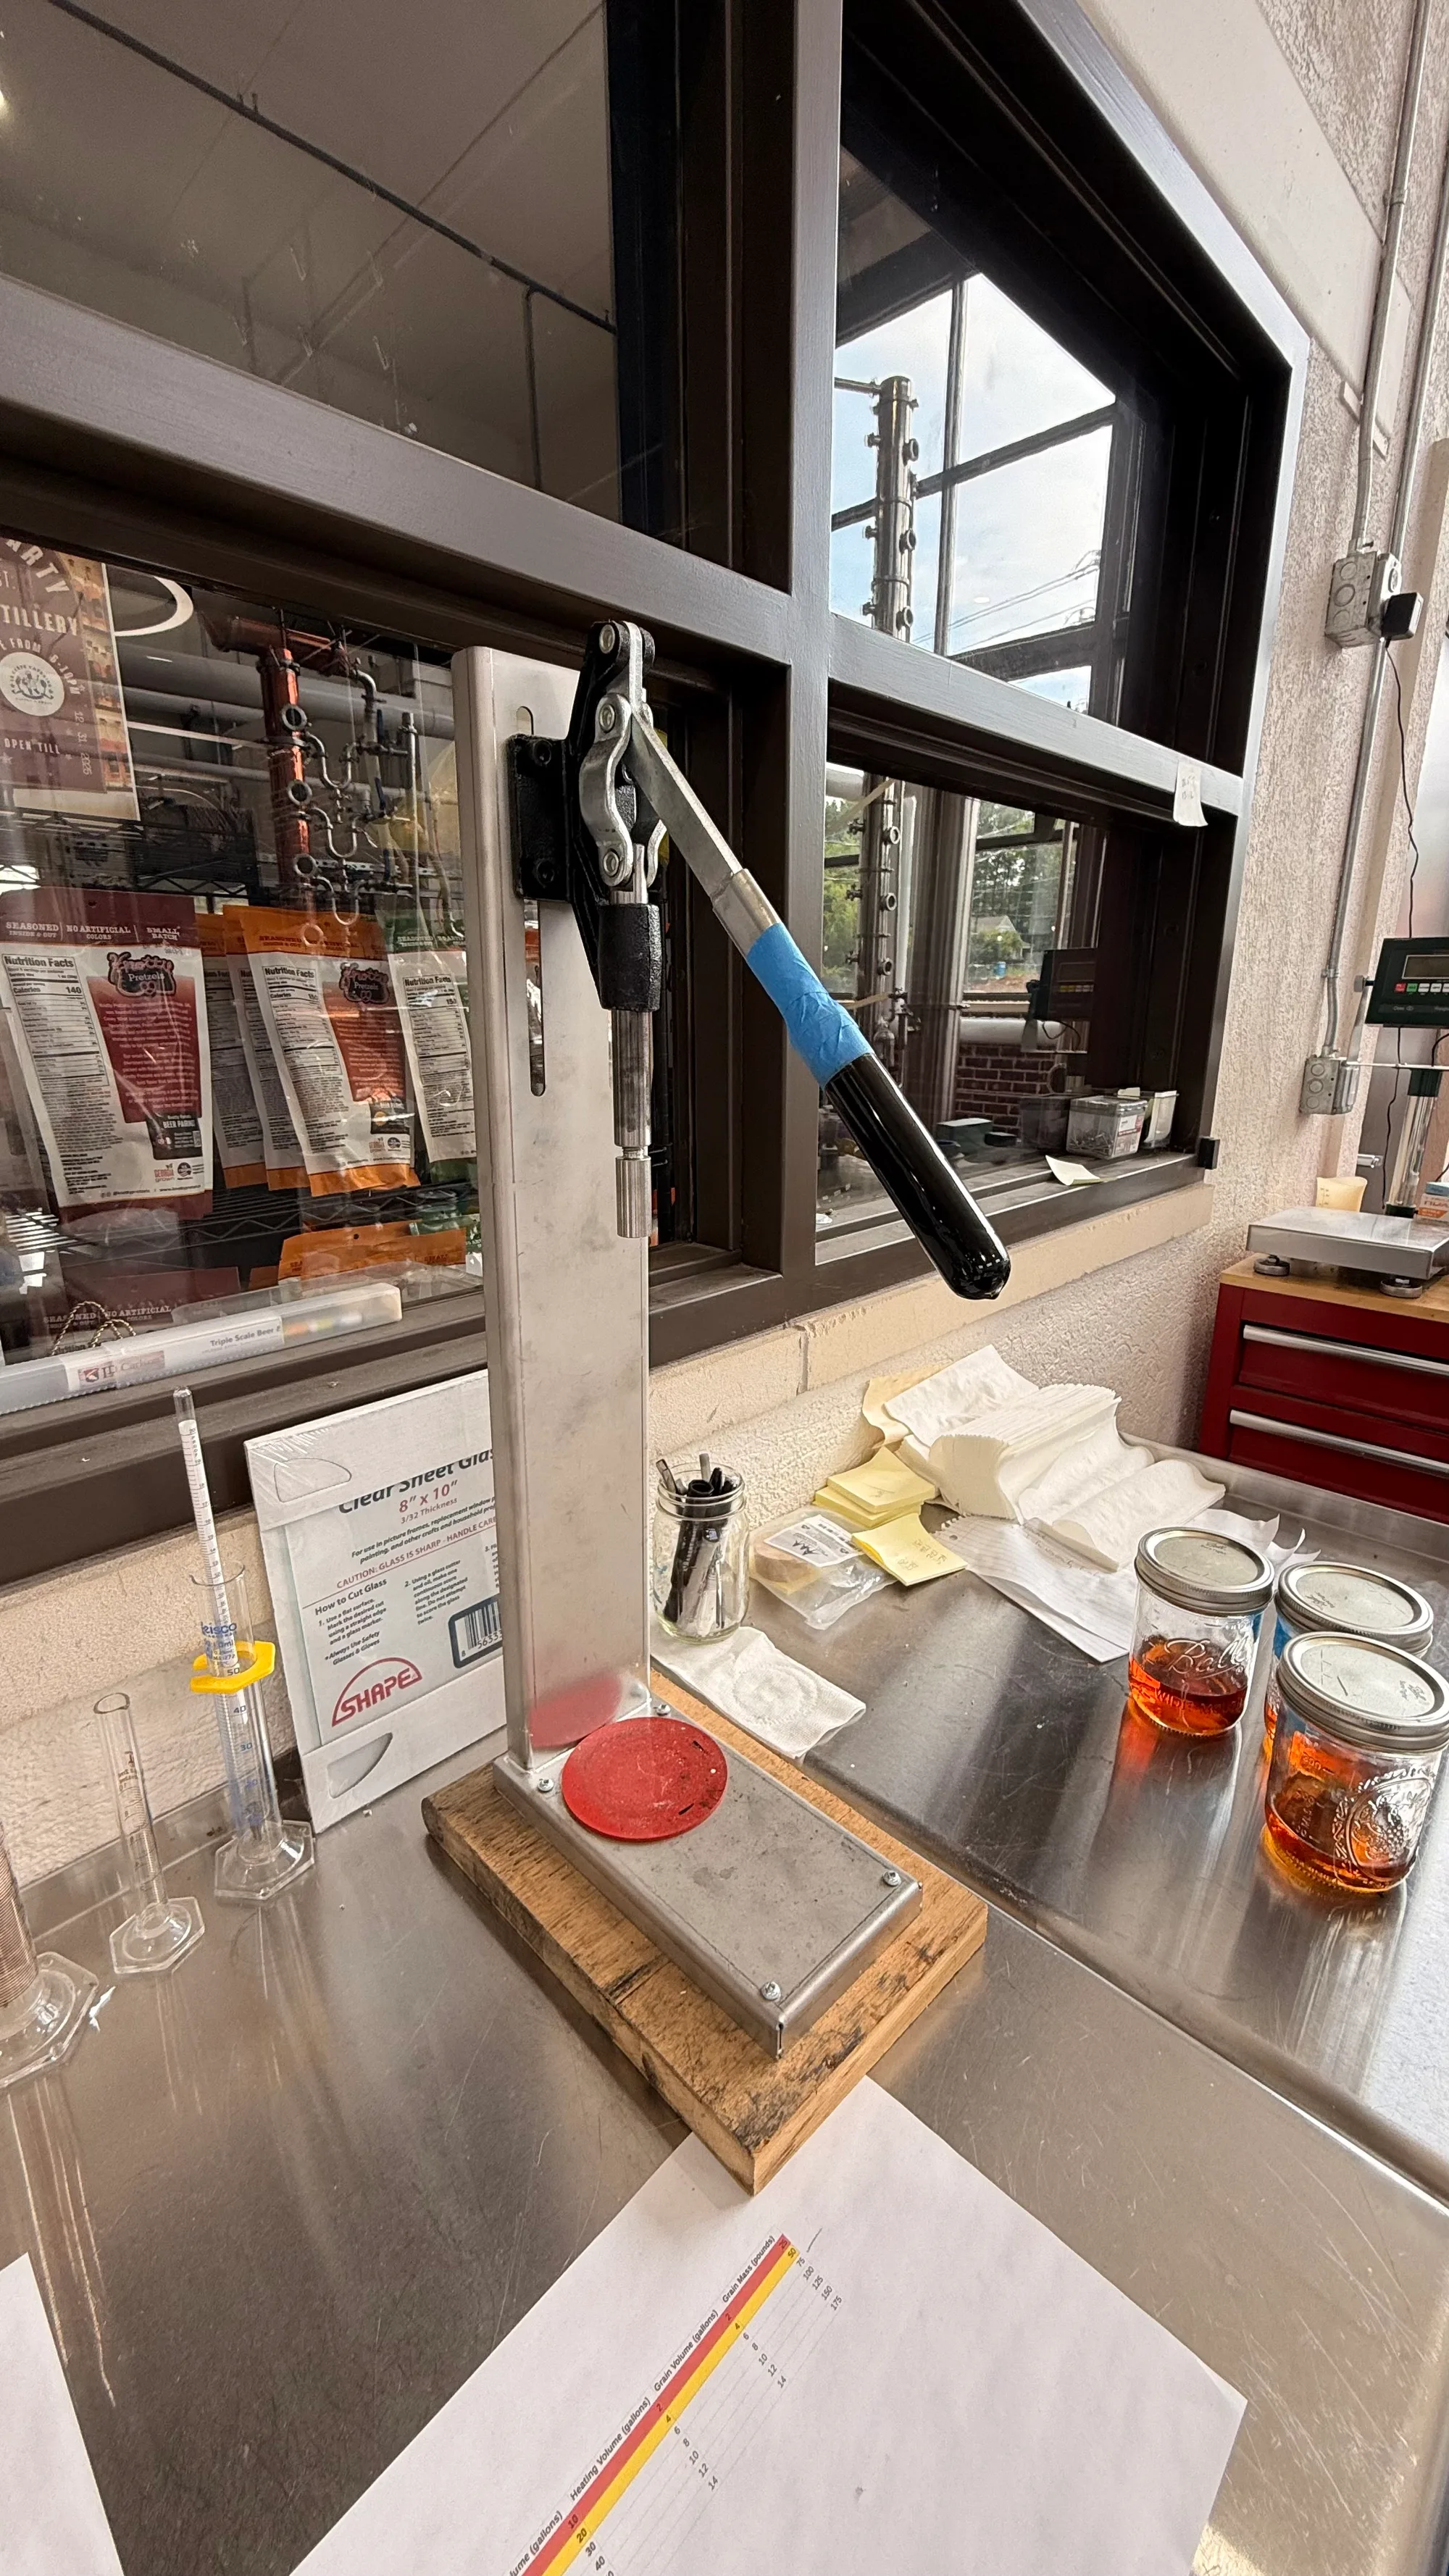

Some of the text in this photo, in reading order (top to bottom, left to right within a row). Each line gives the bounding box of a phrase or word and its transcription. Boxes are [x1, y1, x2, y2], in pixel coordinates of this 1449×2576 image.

[9, 638, 41, 653] FROM
[4, 737, 61, 755] OPEN TILL
[6, 921, 59, 932] SEASONED
[80, 925, 131, 934] ARTIFICIAL
[4, 955, 74, 968] Nutrition Facts
[128, 972, 165, 982] Pretzels
[265, 967, 296, 976] Nutrition
[119, 1305, 172, 1316] ARTIFICIAL
[210, 1337, 233, 1347] Triple
[235, 1332, 255, 1342] Scale
[257, 1328, 274, 1337] Beer
[339, 1486, 396, 1514] Clear
[401, 1497, 458, 1524] 3/32 Thickness
[352, 1550, 363, 1558] For
[383, 1531, 406, 1547] picture
[406, 1523, 430, 1537] frames,
[431, 1507, 468, 1528] replacement
[469, 1499, 491, 1510] window
[360, 1549, 390, 1565] painting,
[391, 1540, 404, 1550] and
[404, 1534, 421, 1545] other
[422, 1526, 440, 1538] crafts
[440, 1521, 452, 1531] and
[453, 1508, 483, 1526] household
[336, 1567, 378, 1589] CAUTION:
[378, 1555, 405, 1571] GLASS
[406, 1550, 414, 1559] IS
[415, 1539, 441, 1555] SHARP
[447, 1524, 477, 1542] HANDLE
[412, 1573, 427, 1584] Using
[432, 1567, 445, 1576] glass
[446, 1560, 461, 1569] cutter
[433, 1572, 446, 1582] make
[414, 1576, 457, 1598] continuous score
[415, 1594, 430, 1605] along
[440, 1576, 468, 1594] designated
[315, 1579, 387, 1615] How to Cut Glass
[416, 1603, 427, 1612] line.
[446, 1585, 466, 1598] attempt
[423, 1606, 437, 1615] score
[447, 1594, 460, 1605] glass
[326, 1614, 337, 1623] Use
[353, 1599, 375, 1610] surface.
[327, 1621, 343, 1631] Mark
[354, 1605, 375, 1618] desired
[328, 1607, 387, 1637] using straight edge
[346, 1627, 361, 1639] glass
[362, 1617, 383, 1630] marker.
[329, 1631, 380, 1659] Always Use Safety
[333, 1651, 355, 1665] Glasses
[361, 1639, 380, 1652] Gloves
[341, 1667, 422, 1718] SHAPE
[233, 1705, 246, 1714] 40
[240, 1742, 252, 1752] 30
[788, 2248, 796, 2259] 50
[722, 2235, 775, 2303] Grain Mass (pounds)
[796, 2257, 806, 2267] 75
[803, 2265, 814, 2280] 100
[812, 2275, 824, 2291] 125
[821, 2286, 832, 2301] 150
[830, 2296, 843, 2311] 175
[654, 2309, 719, 2391] Grain Volume (gallons)
[759, 2354, 768, 2366] 10
[767, 2364, 777, 2377] 12
[777, 2375, 787, 2388] 14
[656, 2403, 663, 2412] 2
[666, 2414, 671, 2423] 4
[675, 2426, 681, 2435] 6
[570, 2396, 651, 2501] Heating Volume (gallons)
[683, 2438, 690, 2447] 8
[689, 2450, 699, 2465] 10
[698, 2463, 709, 2478] 12
[708, 2475, 719, 2491] 14
[567, 2514, 579, 2530] 10
[530, 2510, 563, 2556] (gallons)
[576, 2527, 587, 2543] 20
[585, 2541, 596, 2557] 30
[596, 2555, 605, 2571] 40
